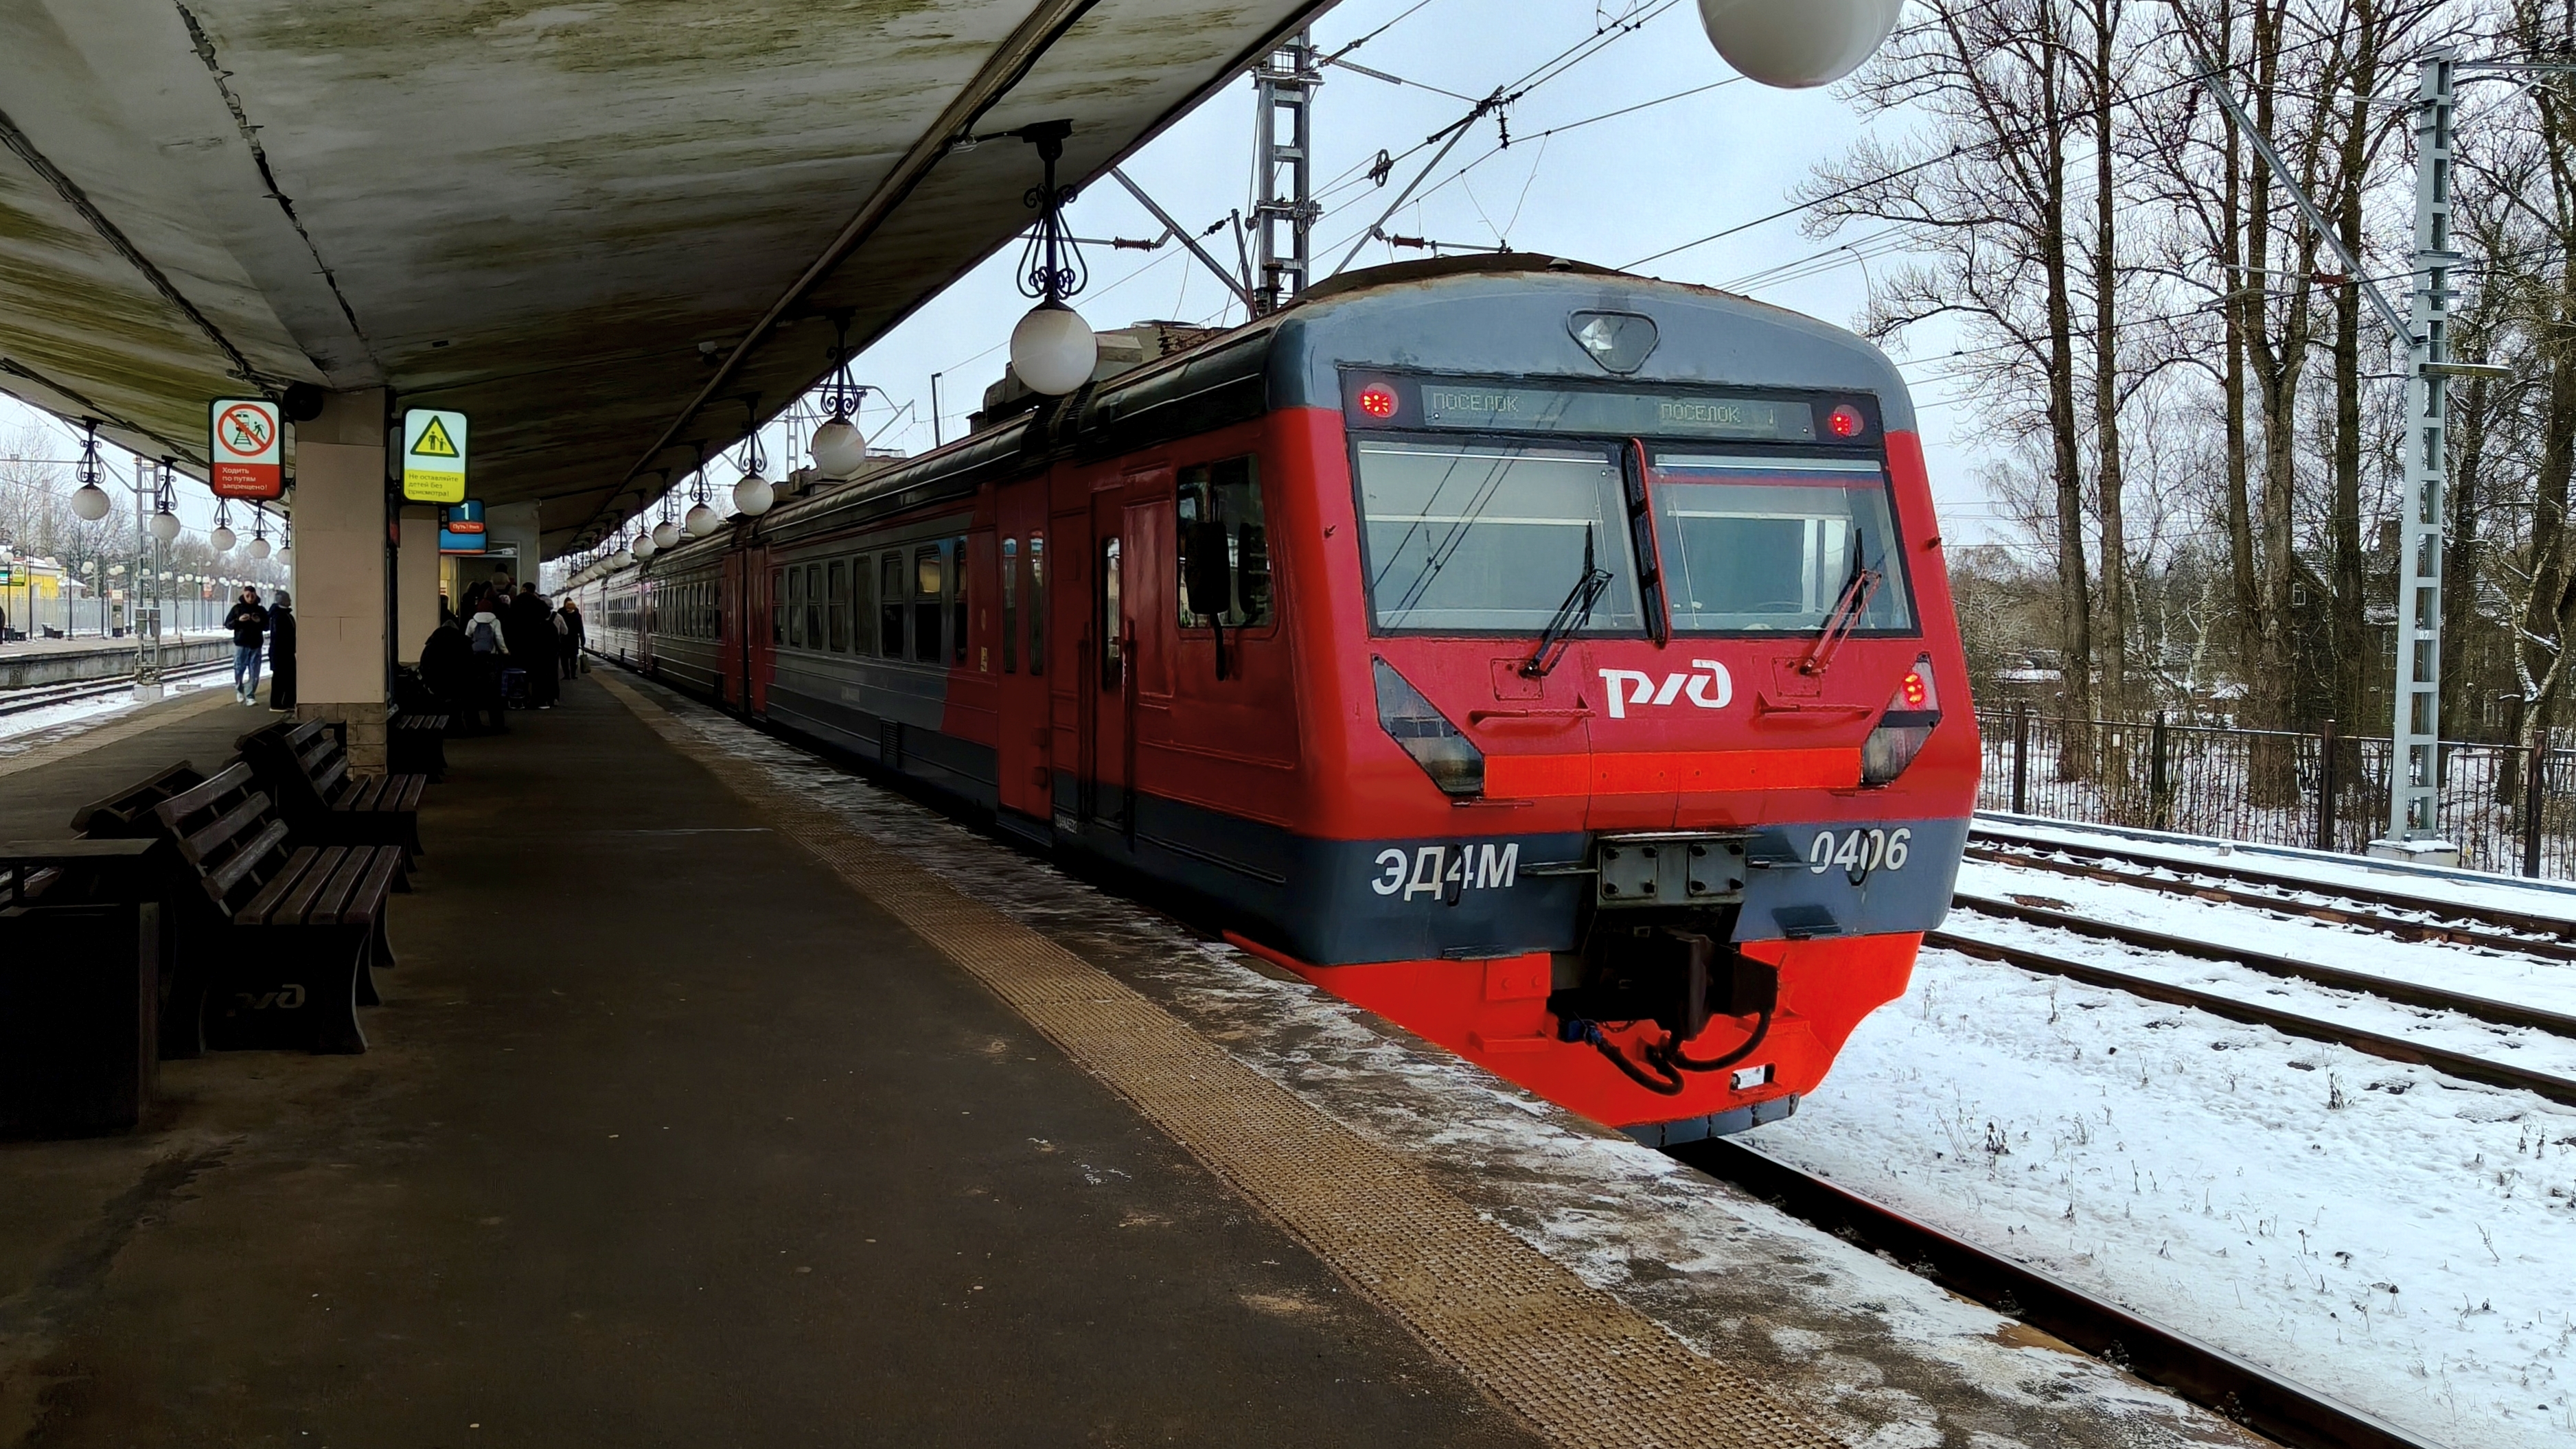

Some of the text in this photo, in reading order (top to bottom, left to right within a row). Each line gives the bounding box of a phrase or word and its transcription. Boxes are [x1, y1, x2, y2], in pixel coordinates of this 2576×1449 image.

[1434, 393, 1519, 413] ПОСЕЛОК
[1661, 403, 1741, 423] ПОСЕЛОК
[222, 467, 250, 475] Ходить
[461, 502, 470, 520] 1
[1810, 827, 1911, 874] 0406
[1372, 843, 1519, 901] ЭД4М
